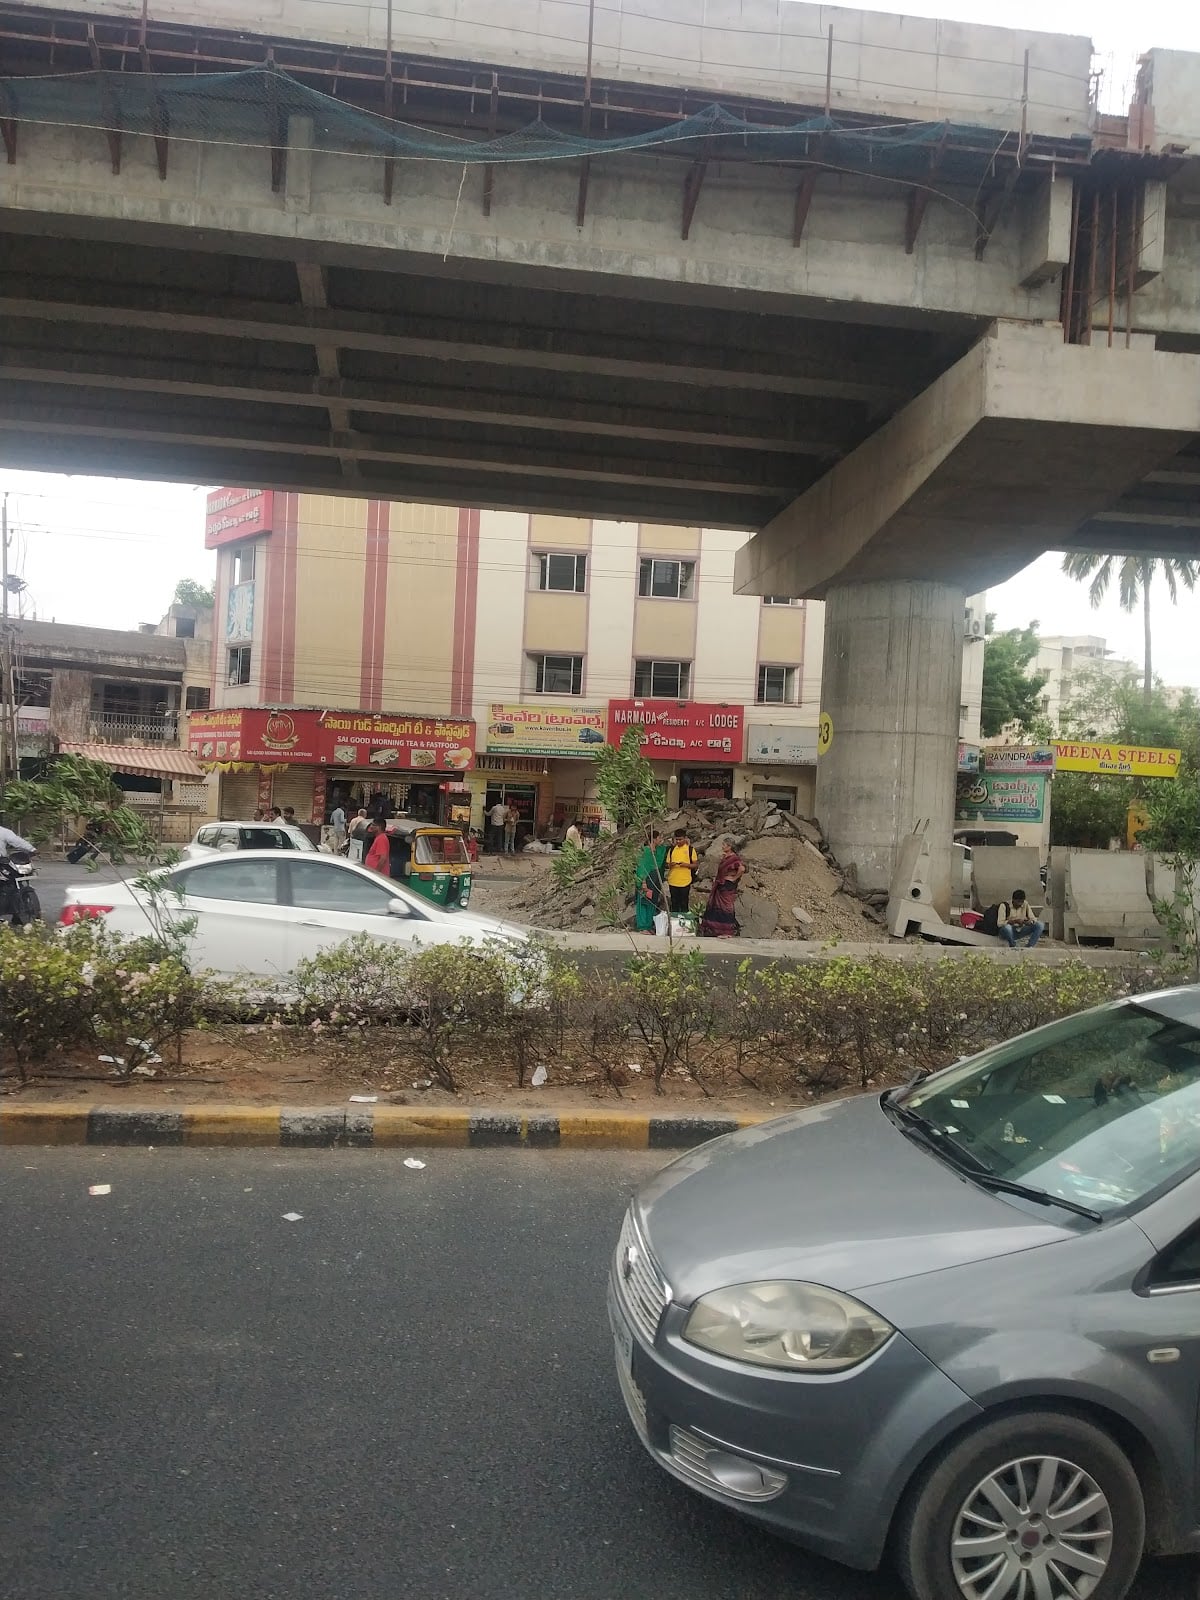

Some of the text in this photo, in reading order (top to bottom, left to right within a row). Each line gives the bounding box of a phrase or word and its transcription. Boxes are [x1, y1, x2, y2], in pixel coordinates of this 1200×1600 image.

[614, 710, 657, 724] NARMADA
[656, 710, 668, 720] NEW
[662, 718, 689, 726] RESIDENCY
[709, 714, 738, 728] LODGE
[425, 725, 431, 735] &
[337, 735, 349, 743] SAI
[349, 736, 370, 744] GOOD
[372, 737, 404, 746] MORNING
[405, 739, 418, 747] TEA
[426, 741, 459, 749] FASTFOOD
[988, 752, 1032, 761] RAVINDRA
[1056, 744, 1177, 765] MEENA STEELS
